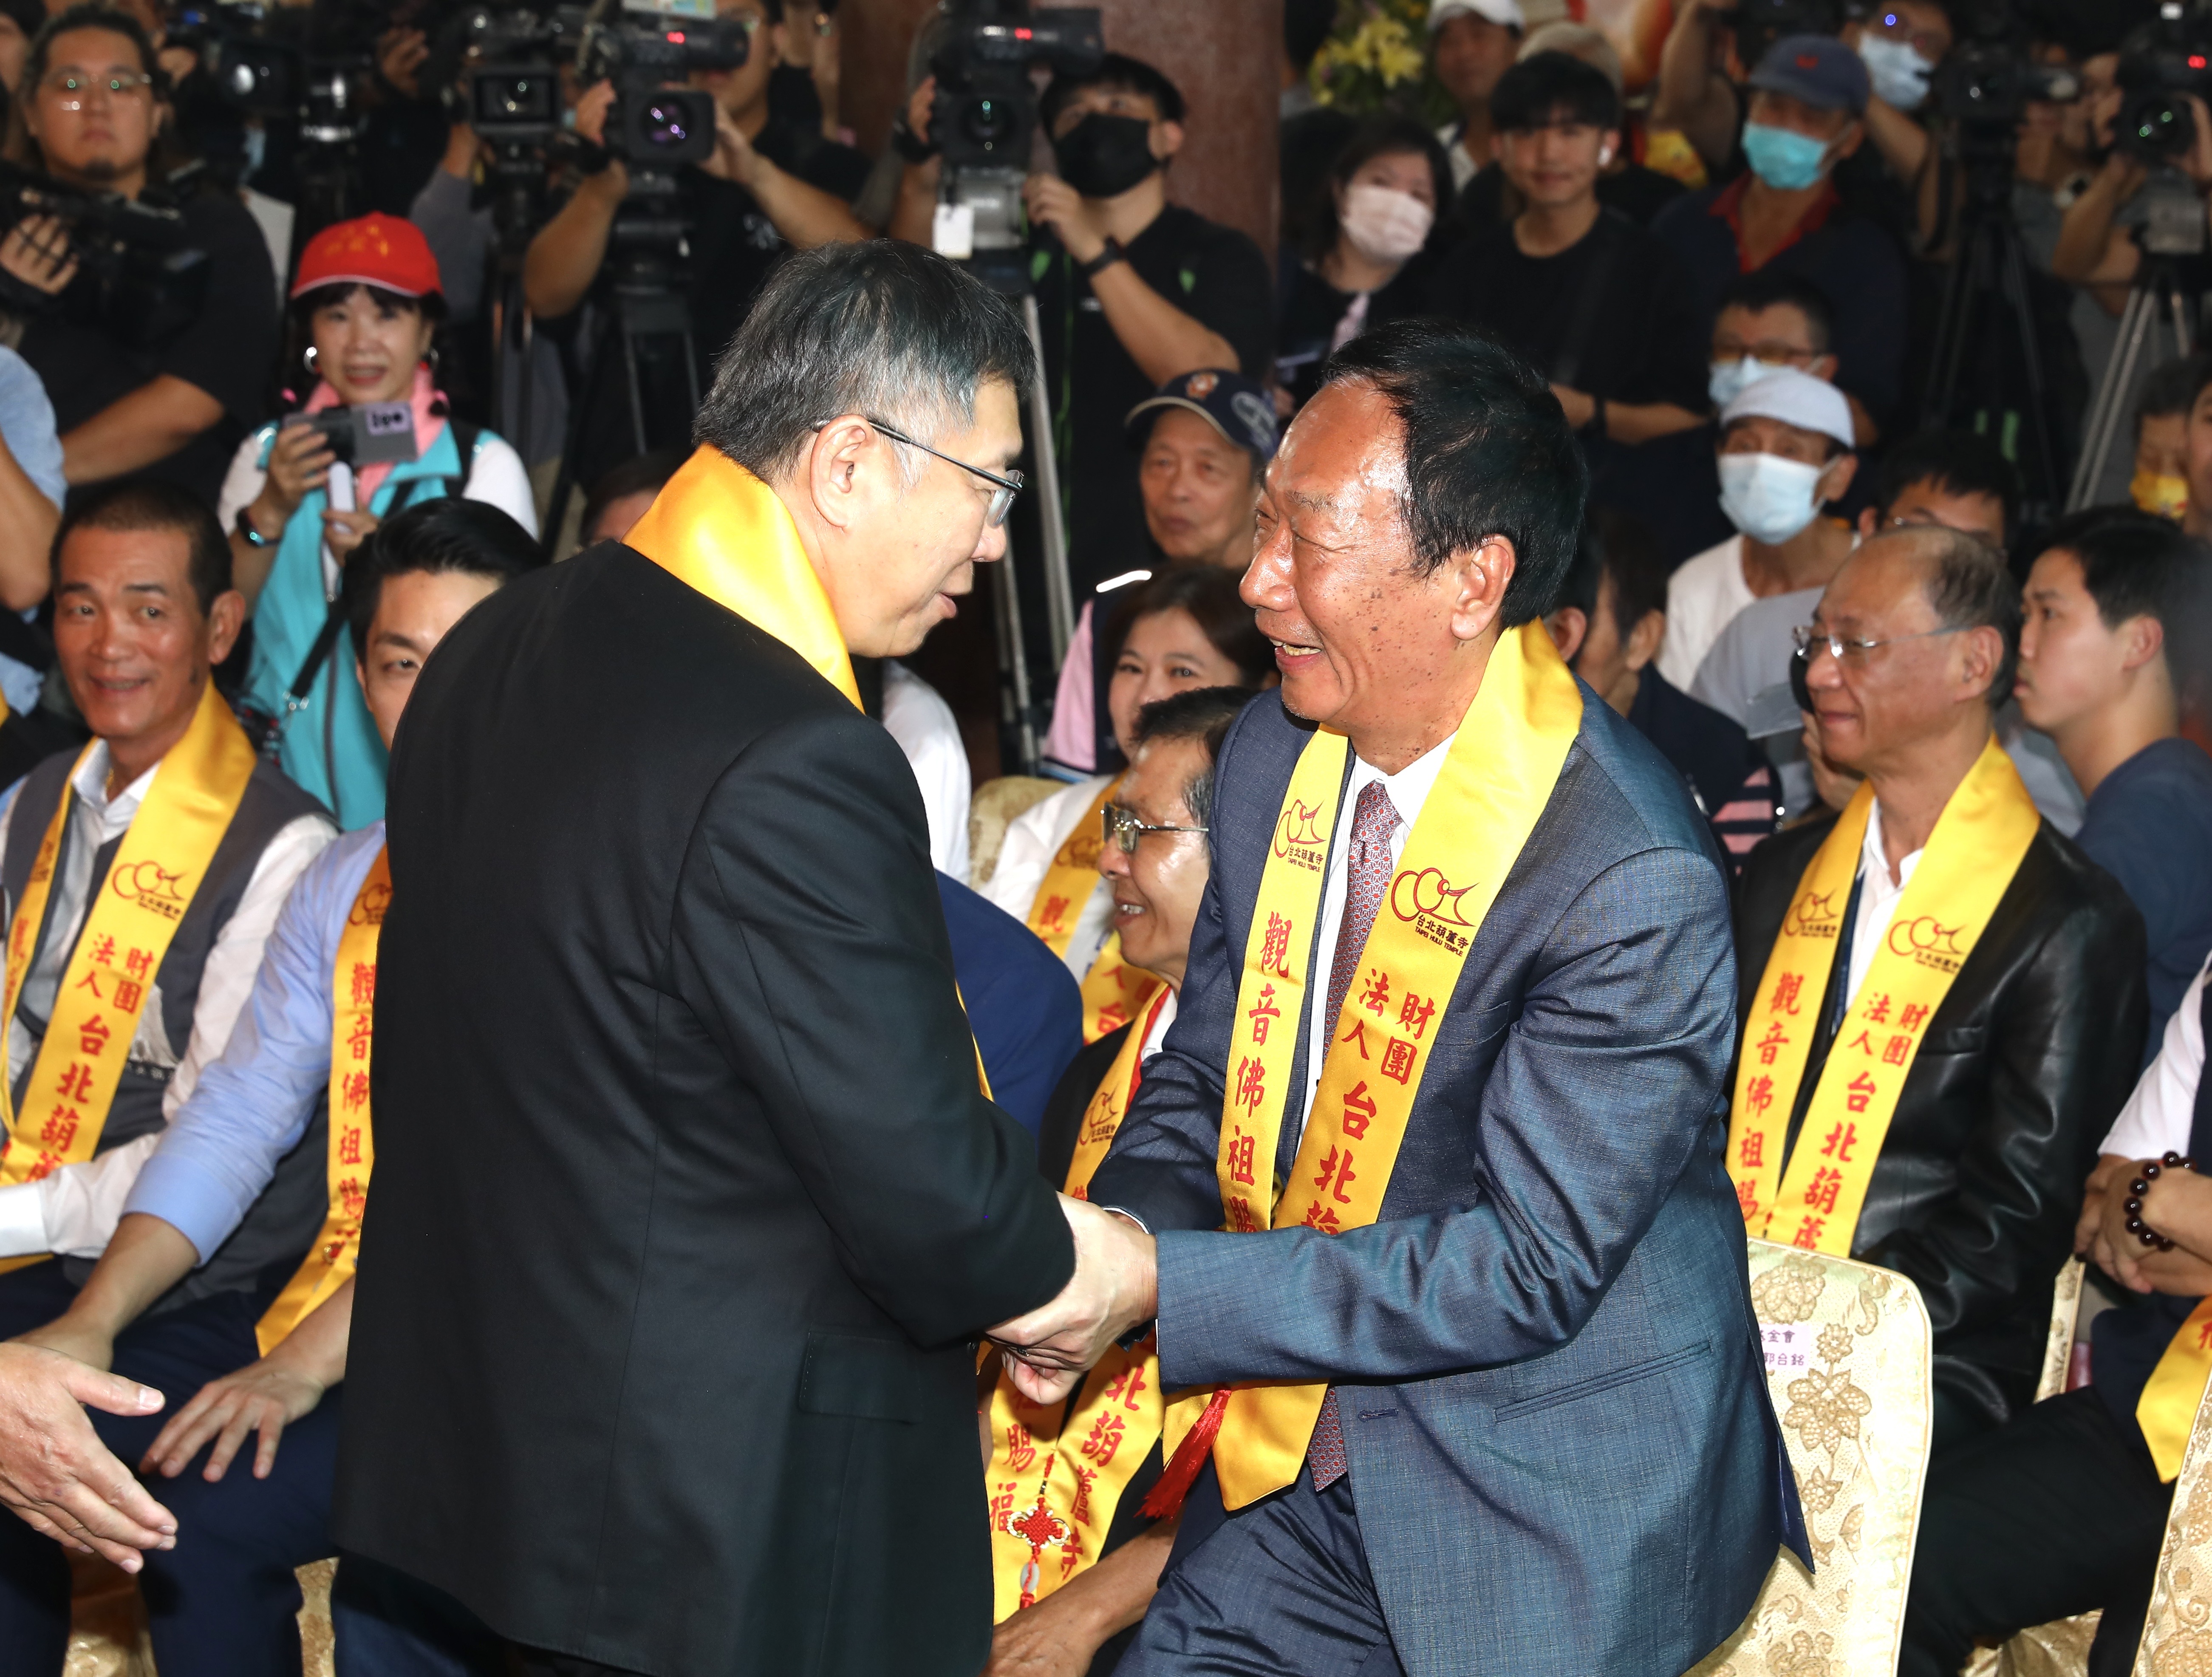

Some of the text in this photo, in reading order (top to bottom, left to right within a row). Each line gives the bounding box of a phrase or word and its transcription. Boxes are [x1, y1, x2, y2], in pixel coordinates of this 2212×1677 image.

[1289, 845, 1324, 865] 台北葫蘆寺
[1307, 863, 1321, 872] TEMPLE
[1415, 926, 1463, 957] TAIPEI HULU TEMPLE
[1417, 914, 1469, 949] 台北葫蘆寺
[76, 933, 115, 999] 法人
[112, 945, 155, 1016] 財團
[1341, 968, 1389, 1060] 法人
[1381, 990, 1436, 1086] 財團
[1847, 992, 1892, 1056] 法人
[1882, 1003, 1929, 1067] 財團
[1764, 1352, 1805, 1366] 郭台銘
[989, 1396, 1043, 1532] 賜福
